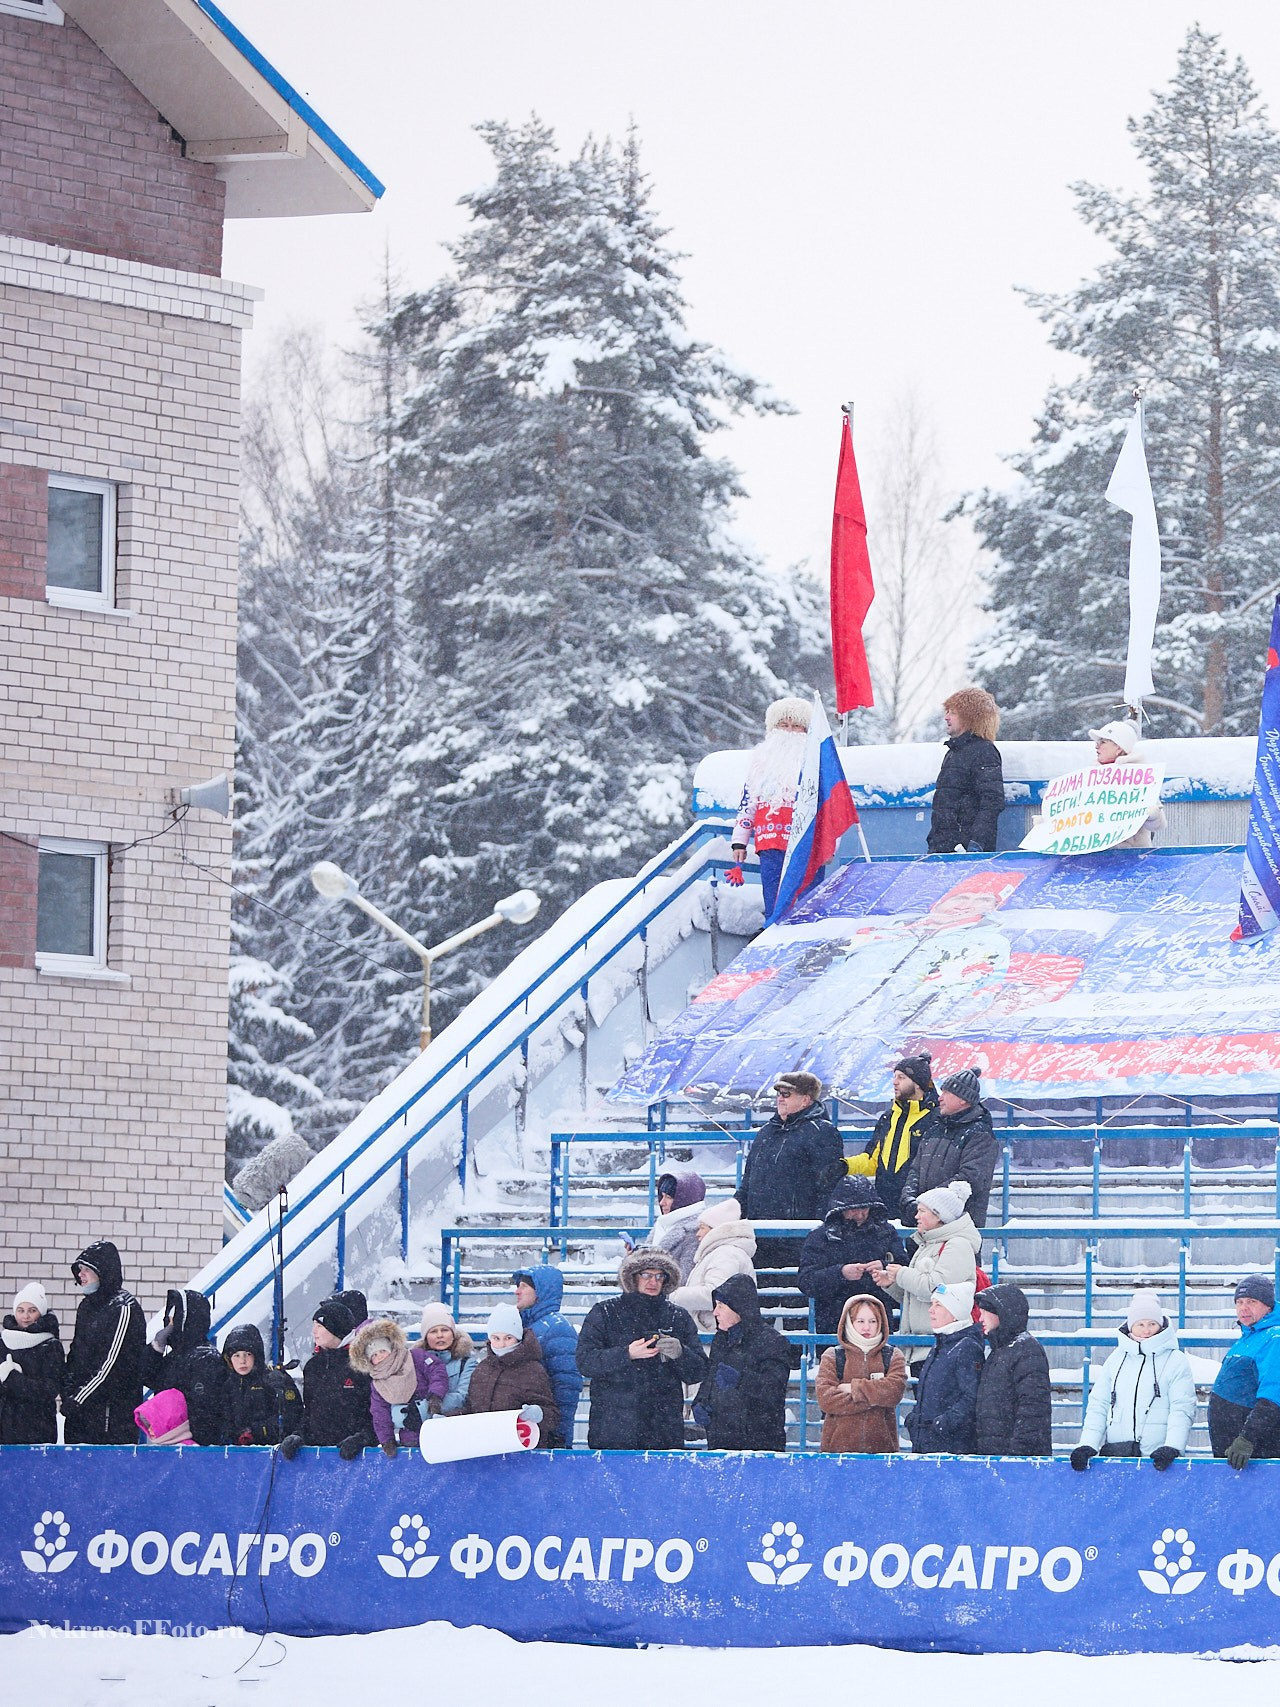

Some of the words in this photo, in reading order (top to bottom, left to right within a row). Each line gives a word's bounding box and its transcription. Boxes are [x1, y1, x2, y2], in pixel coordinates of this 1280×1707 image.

[1045, 772, 1083, 800] ДИМА
[1049, 791, 1082, 817] БЕГИ!
[1084, 787, 1147, 806] ДАВАЙ!
[1049, 811, 1093, 835] ЗОЛОТО
